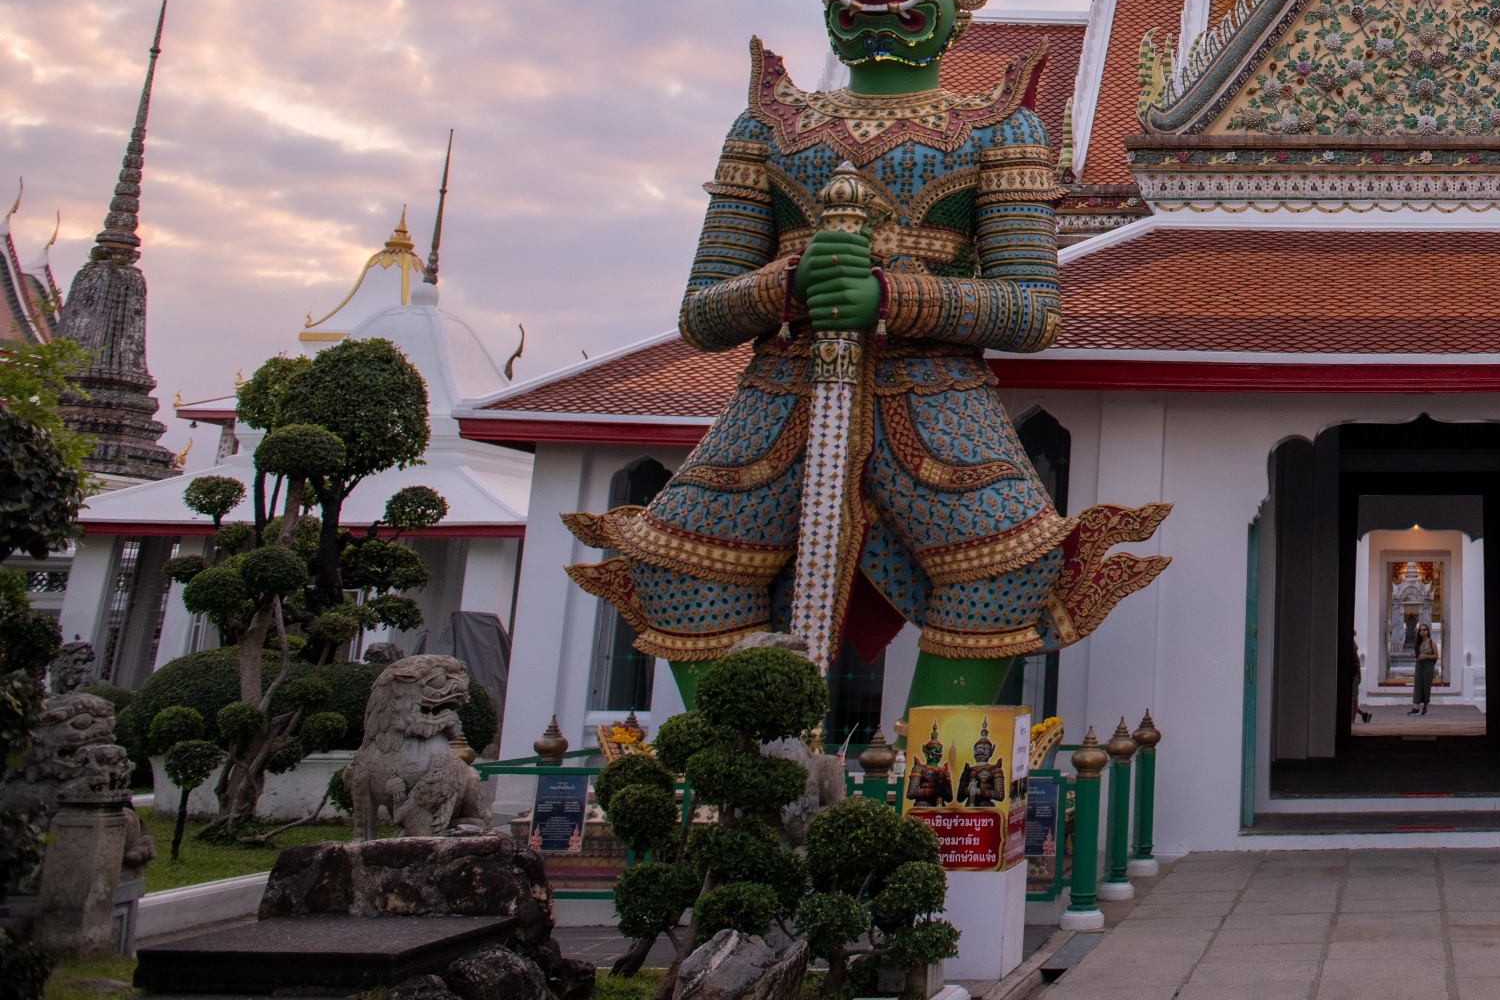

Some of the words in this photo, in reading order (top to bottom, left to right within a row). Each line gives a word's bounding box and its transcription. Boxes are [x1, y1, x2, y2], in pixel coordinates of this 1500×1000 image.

[924, 815, 994, 831] อเชิญร่วมบูชา
[938, 834, 980, 845] วงมาลัย
[938, 849, 996, 863] ญายักษ์วัดแจ้ง
